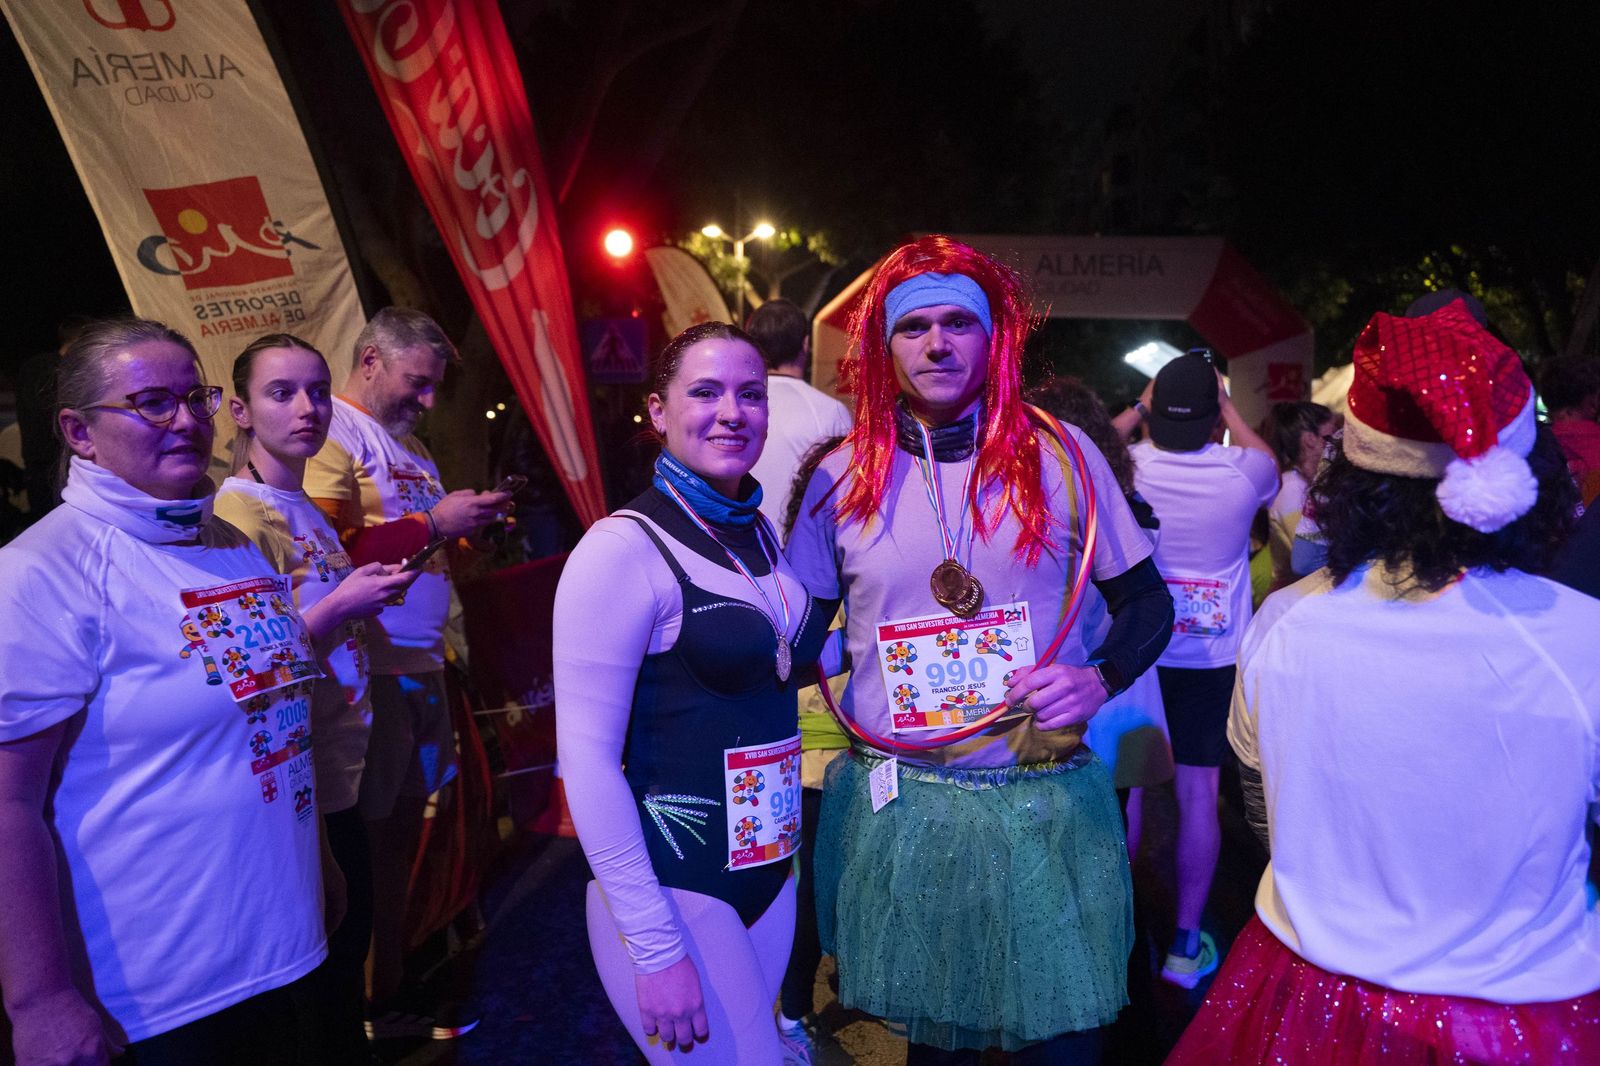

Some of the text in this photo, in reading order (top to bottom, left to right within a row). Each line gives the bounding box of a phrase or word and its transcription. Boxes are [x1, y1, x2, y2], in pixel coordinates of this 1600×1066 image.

[235, 616, 295, 649] 2107
[906, 622, 918, 631] SAN
[918, 619, 945, 629] SILVESTRE
[925, 656, 989, 688] 990
[931, 682, 986, 695] FRANCISCO JESUS
[276, 699, 308, 732] 2005
[957, 705, 991, 718] ALMERÍA
[757, 750, 768, 759] SAN
[770, 783, 800, 817] 991
